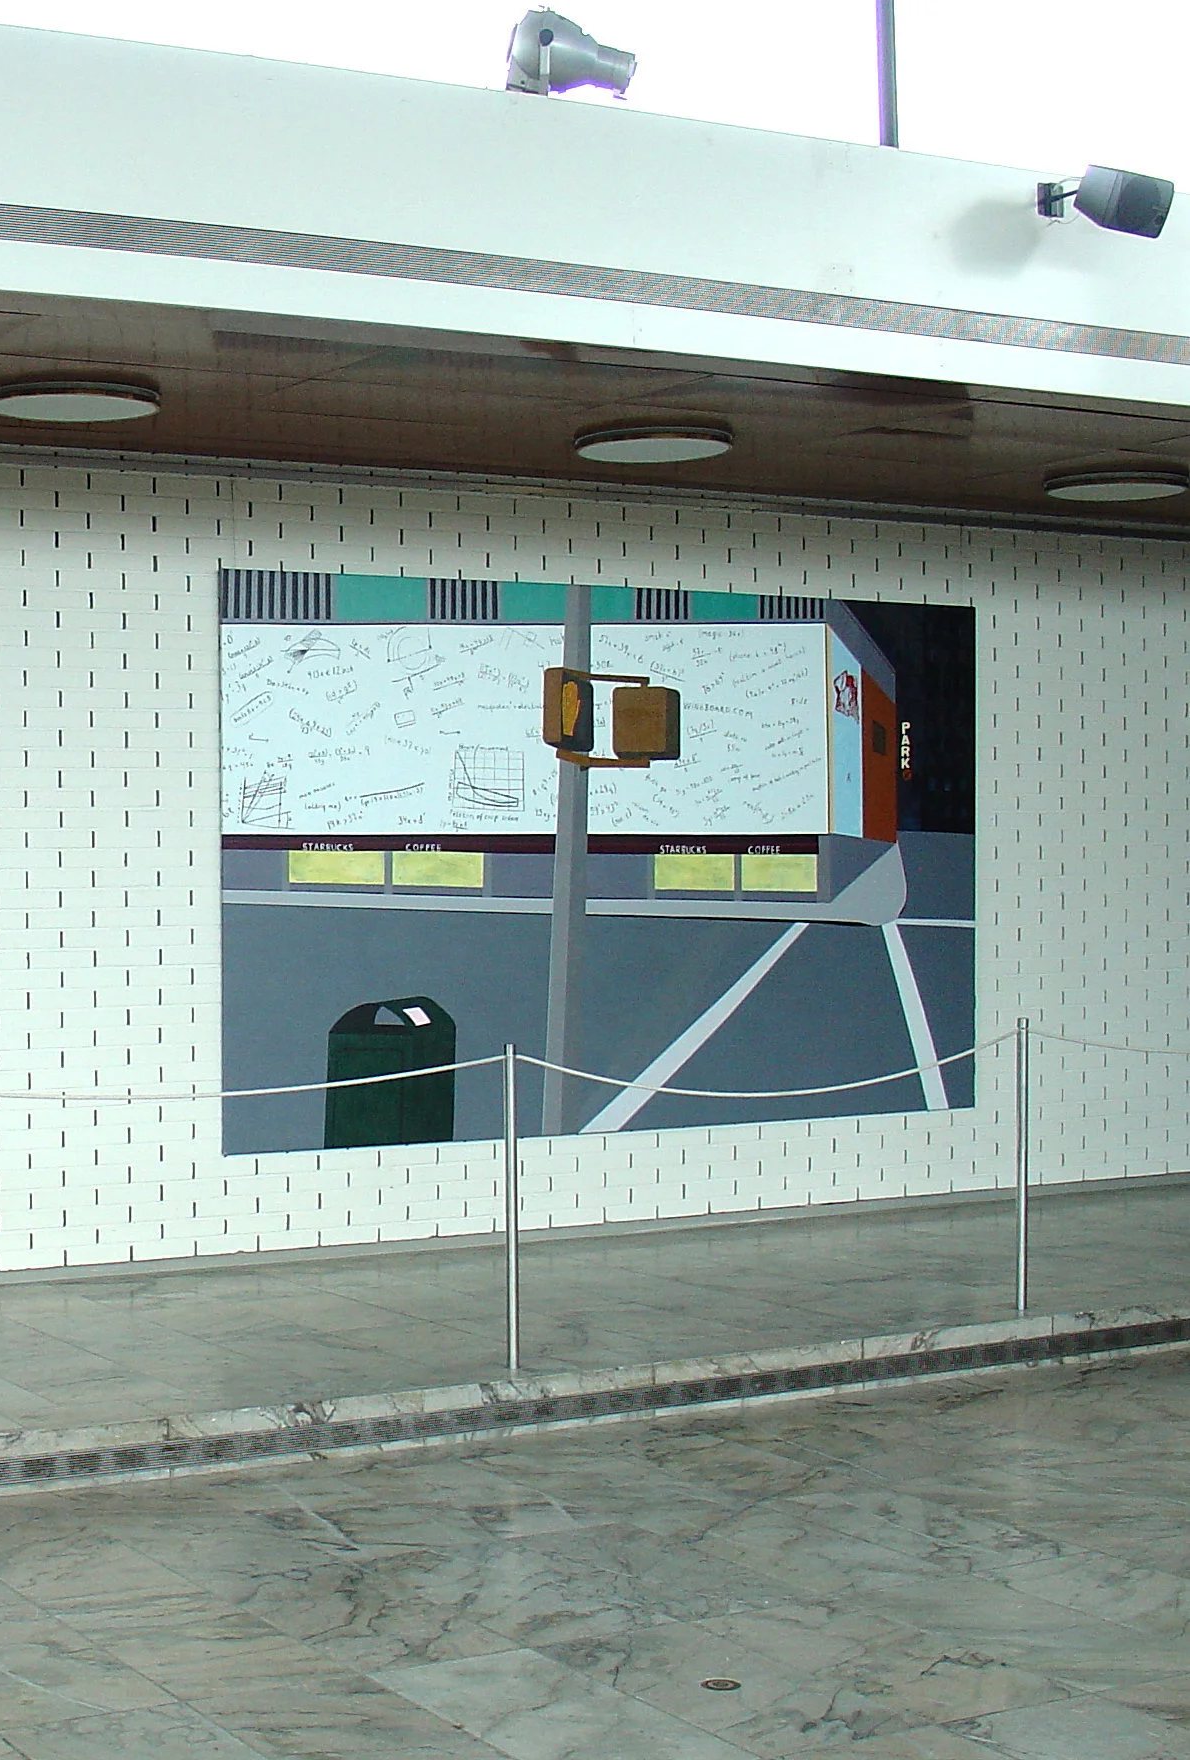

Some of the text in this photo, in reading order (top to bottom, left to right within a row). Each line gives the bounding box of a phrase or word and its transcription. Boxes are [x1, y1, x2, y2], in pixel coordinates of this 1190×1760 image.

[900, 721, 911, 770] PARK
[302, 842, 442, 851] STARBUCKS COFFEE
[659, 844, 781, 854] STARBUCKS COFFEE
